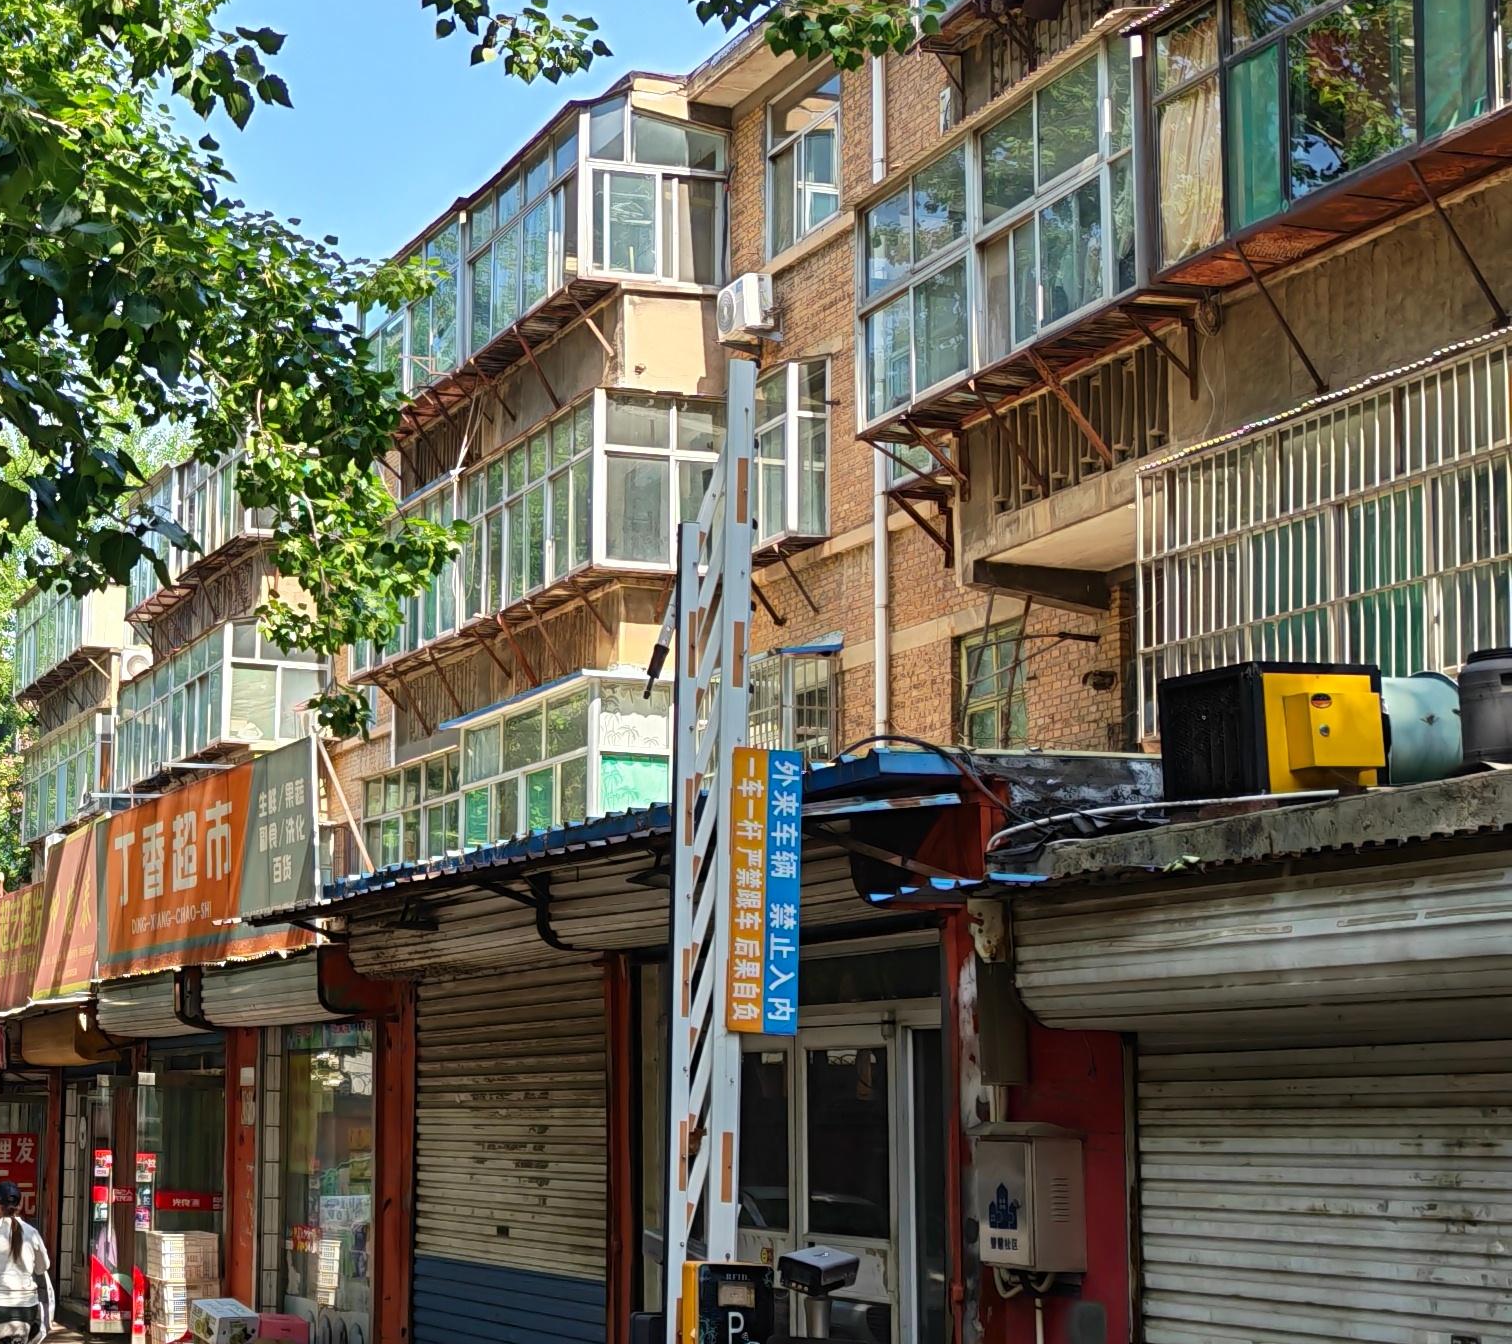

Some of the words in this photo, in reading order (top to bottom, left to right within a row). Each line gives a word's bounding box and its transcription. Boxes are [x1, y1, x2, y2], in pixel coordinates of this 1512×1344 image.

[735, 756, 765, 841] 一车一杆
[770, 759, 800, 880] 外来车辆
[114, 800, 233, 907] 丁香超市
[272, 853, 292, 884] 百货
[731, 937, 761, 1021] 后果自负
[767, 903, 798, 1022] 禁止入内
